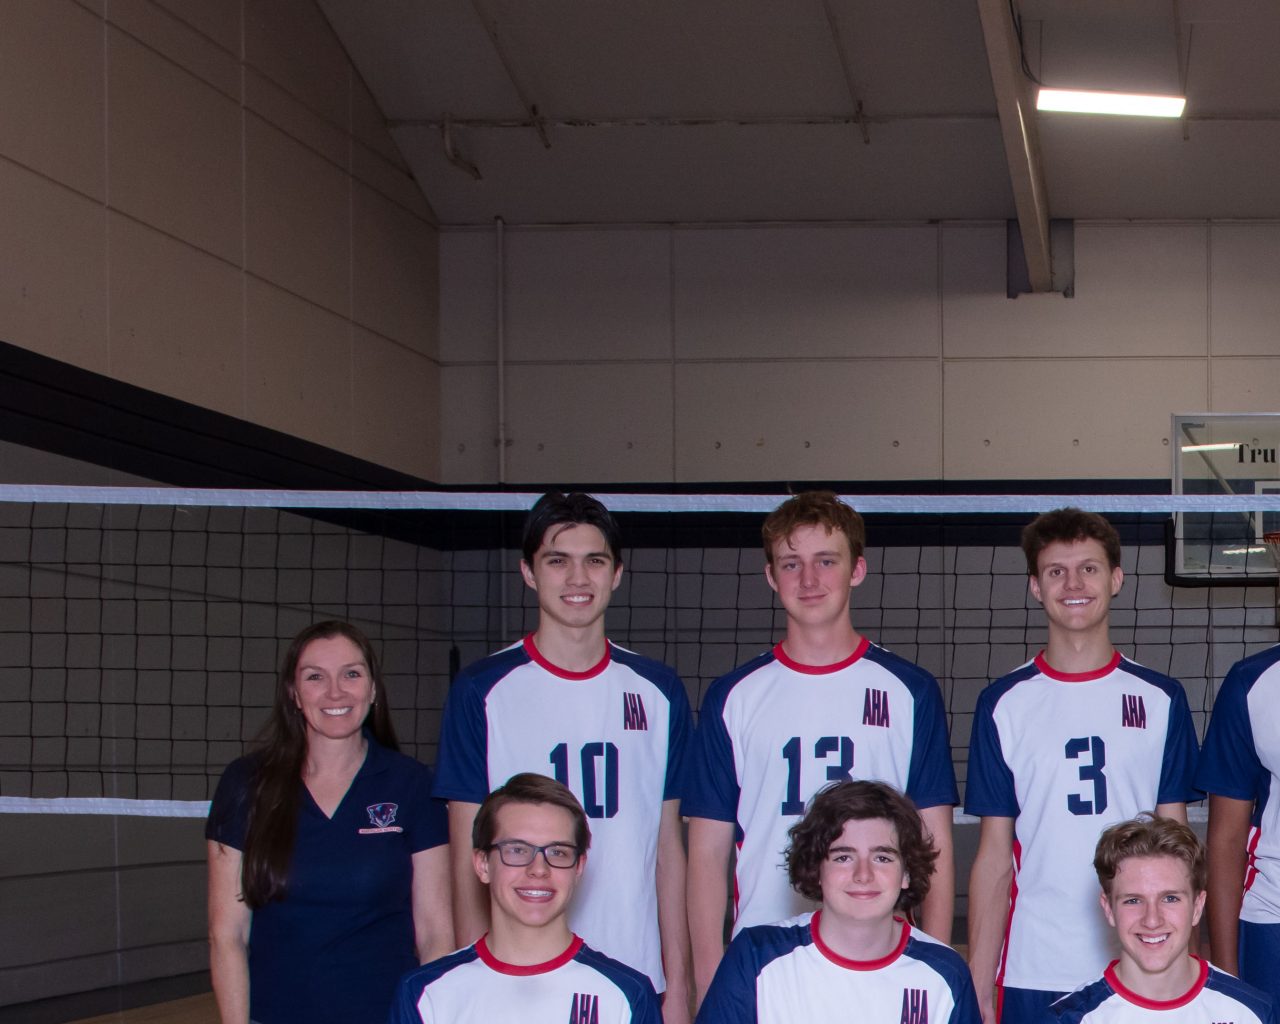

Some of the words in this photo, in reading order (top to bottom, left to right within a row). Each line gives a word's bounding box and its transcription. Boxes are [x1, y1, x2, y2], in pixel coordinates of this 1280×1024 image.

[624, 692, 647, 731] AHA
[863, 688, 889, 728] AHA
[1122, 694, 1146, 729] AHA
[550, 742, 619, 818] 10
[1065, 736, 1107, 815] 3
